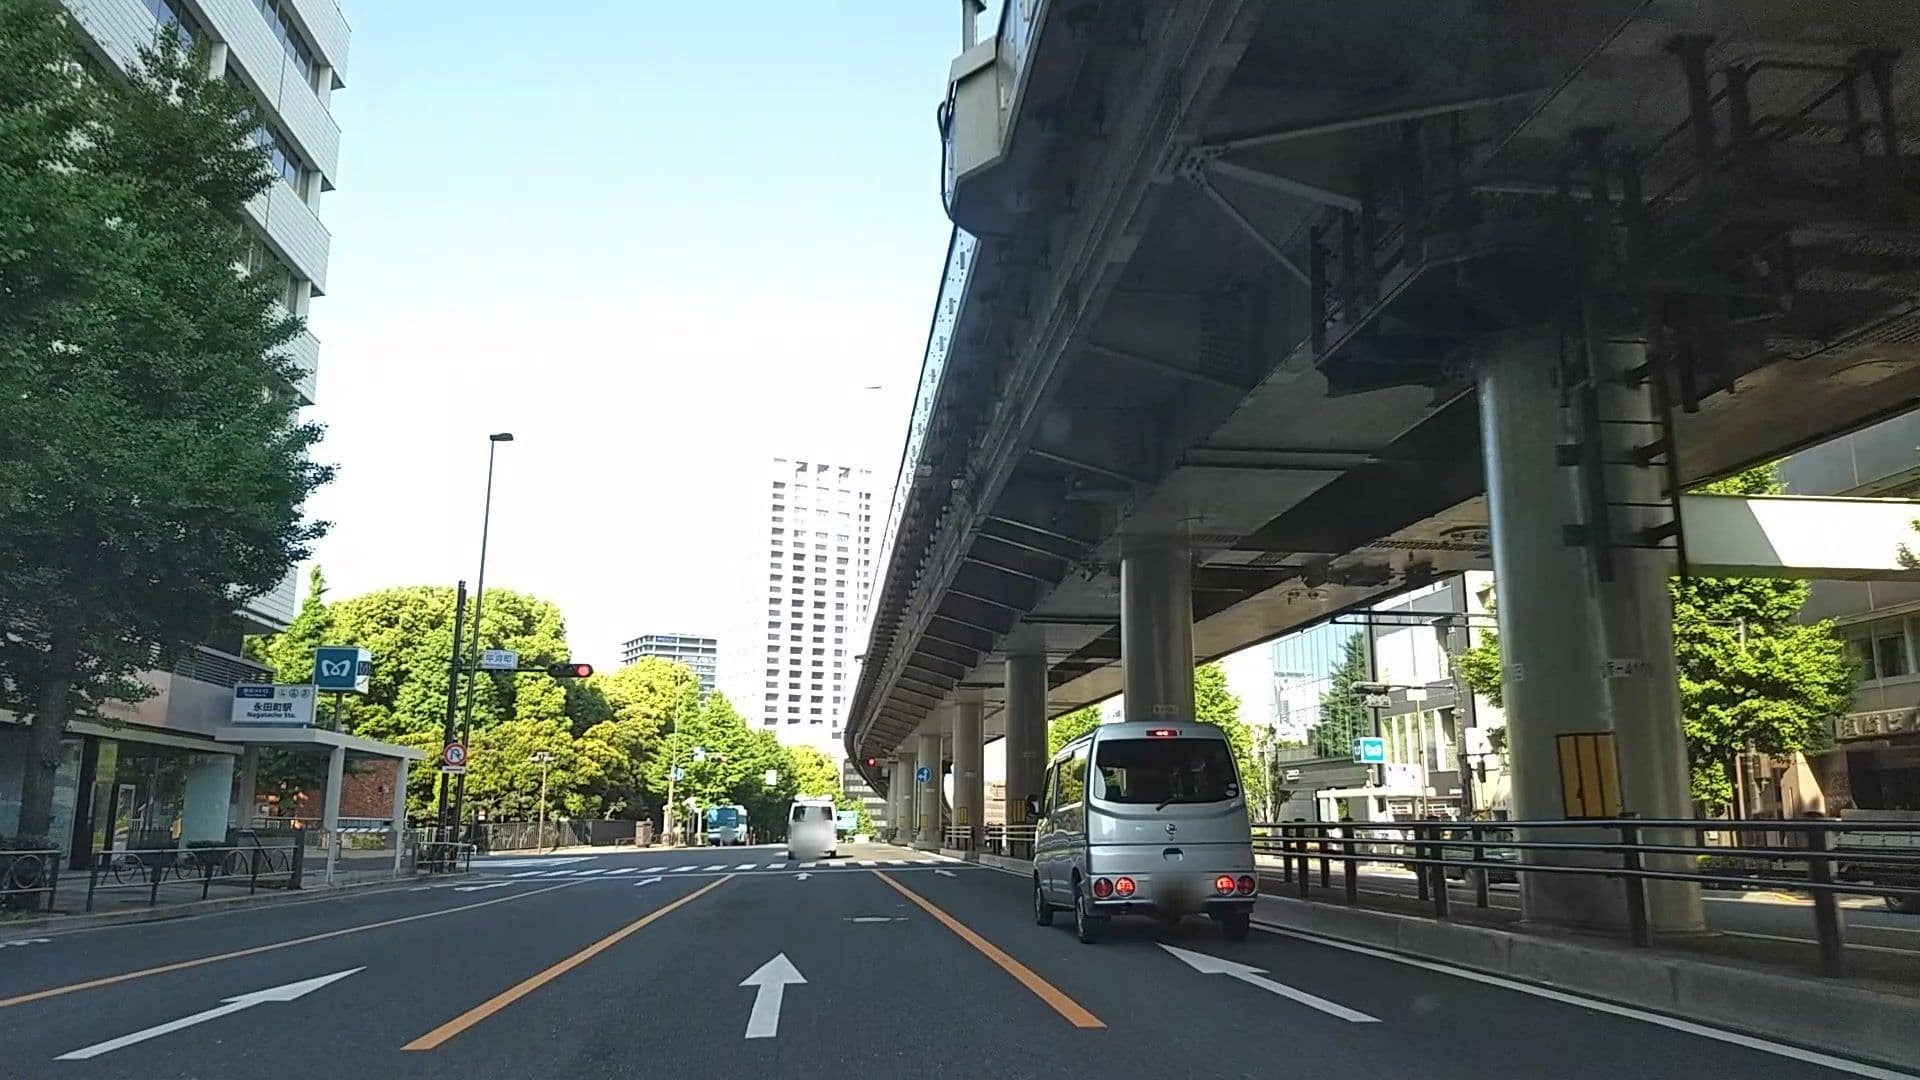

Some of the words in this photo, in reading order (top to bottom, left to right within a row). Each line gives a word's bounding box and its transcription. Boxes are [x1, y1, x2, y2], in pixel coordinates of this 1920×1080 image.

[254, 702, 293, 712] 永田町駅
[247, 711, 283, 719] Nagatacho
